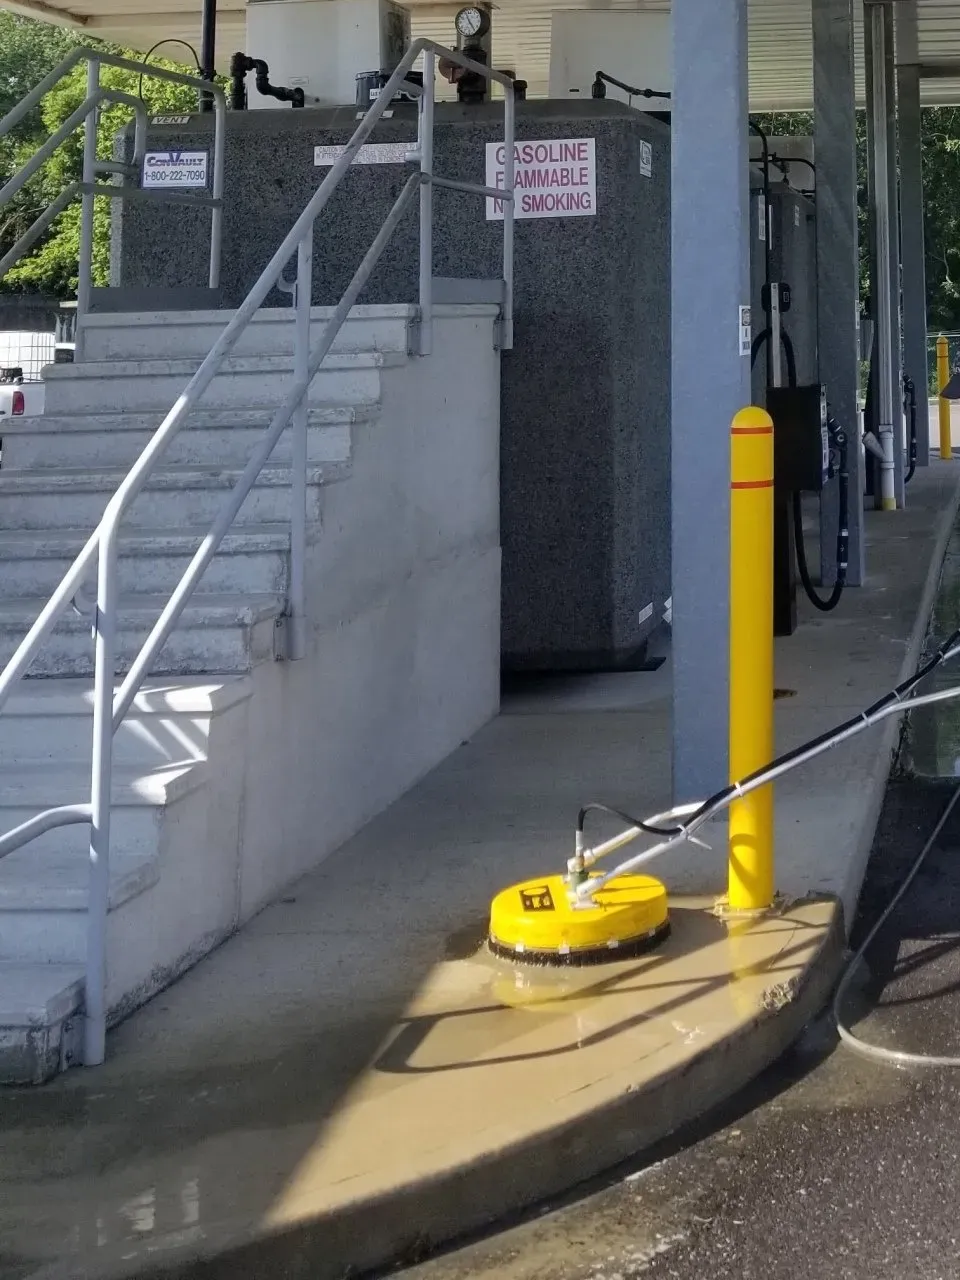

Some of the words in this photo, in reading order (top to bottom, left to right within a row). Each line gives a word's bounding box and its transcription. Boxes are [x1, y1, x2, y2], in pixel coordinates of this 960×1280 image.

[495, 142, 588, 165] GASOLINE
[145, 170, 205, 181] 1-800-222-7090
[495, 167, 589, 189] FAMMABLE
[521, 192, 591, 213] SMOKING
